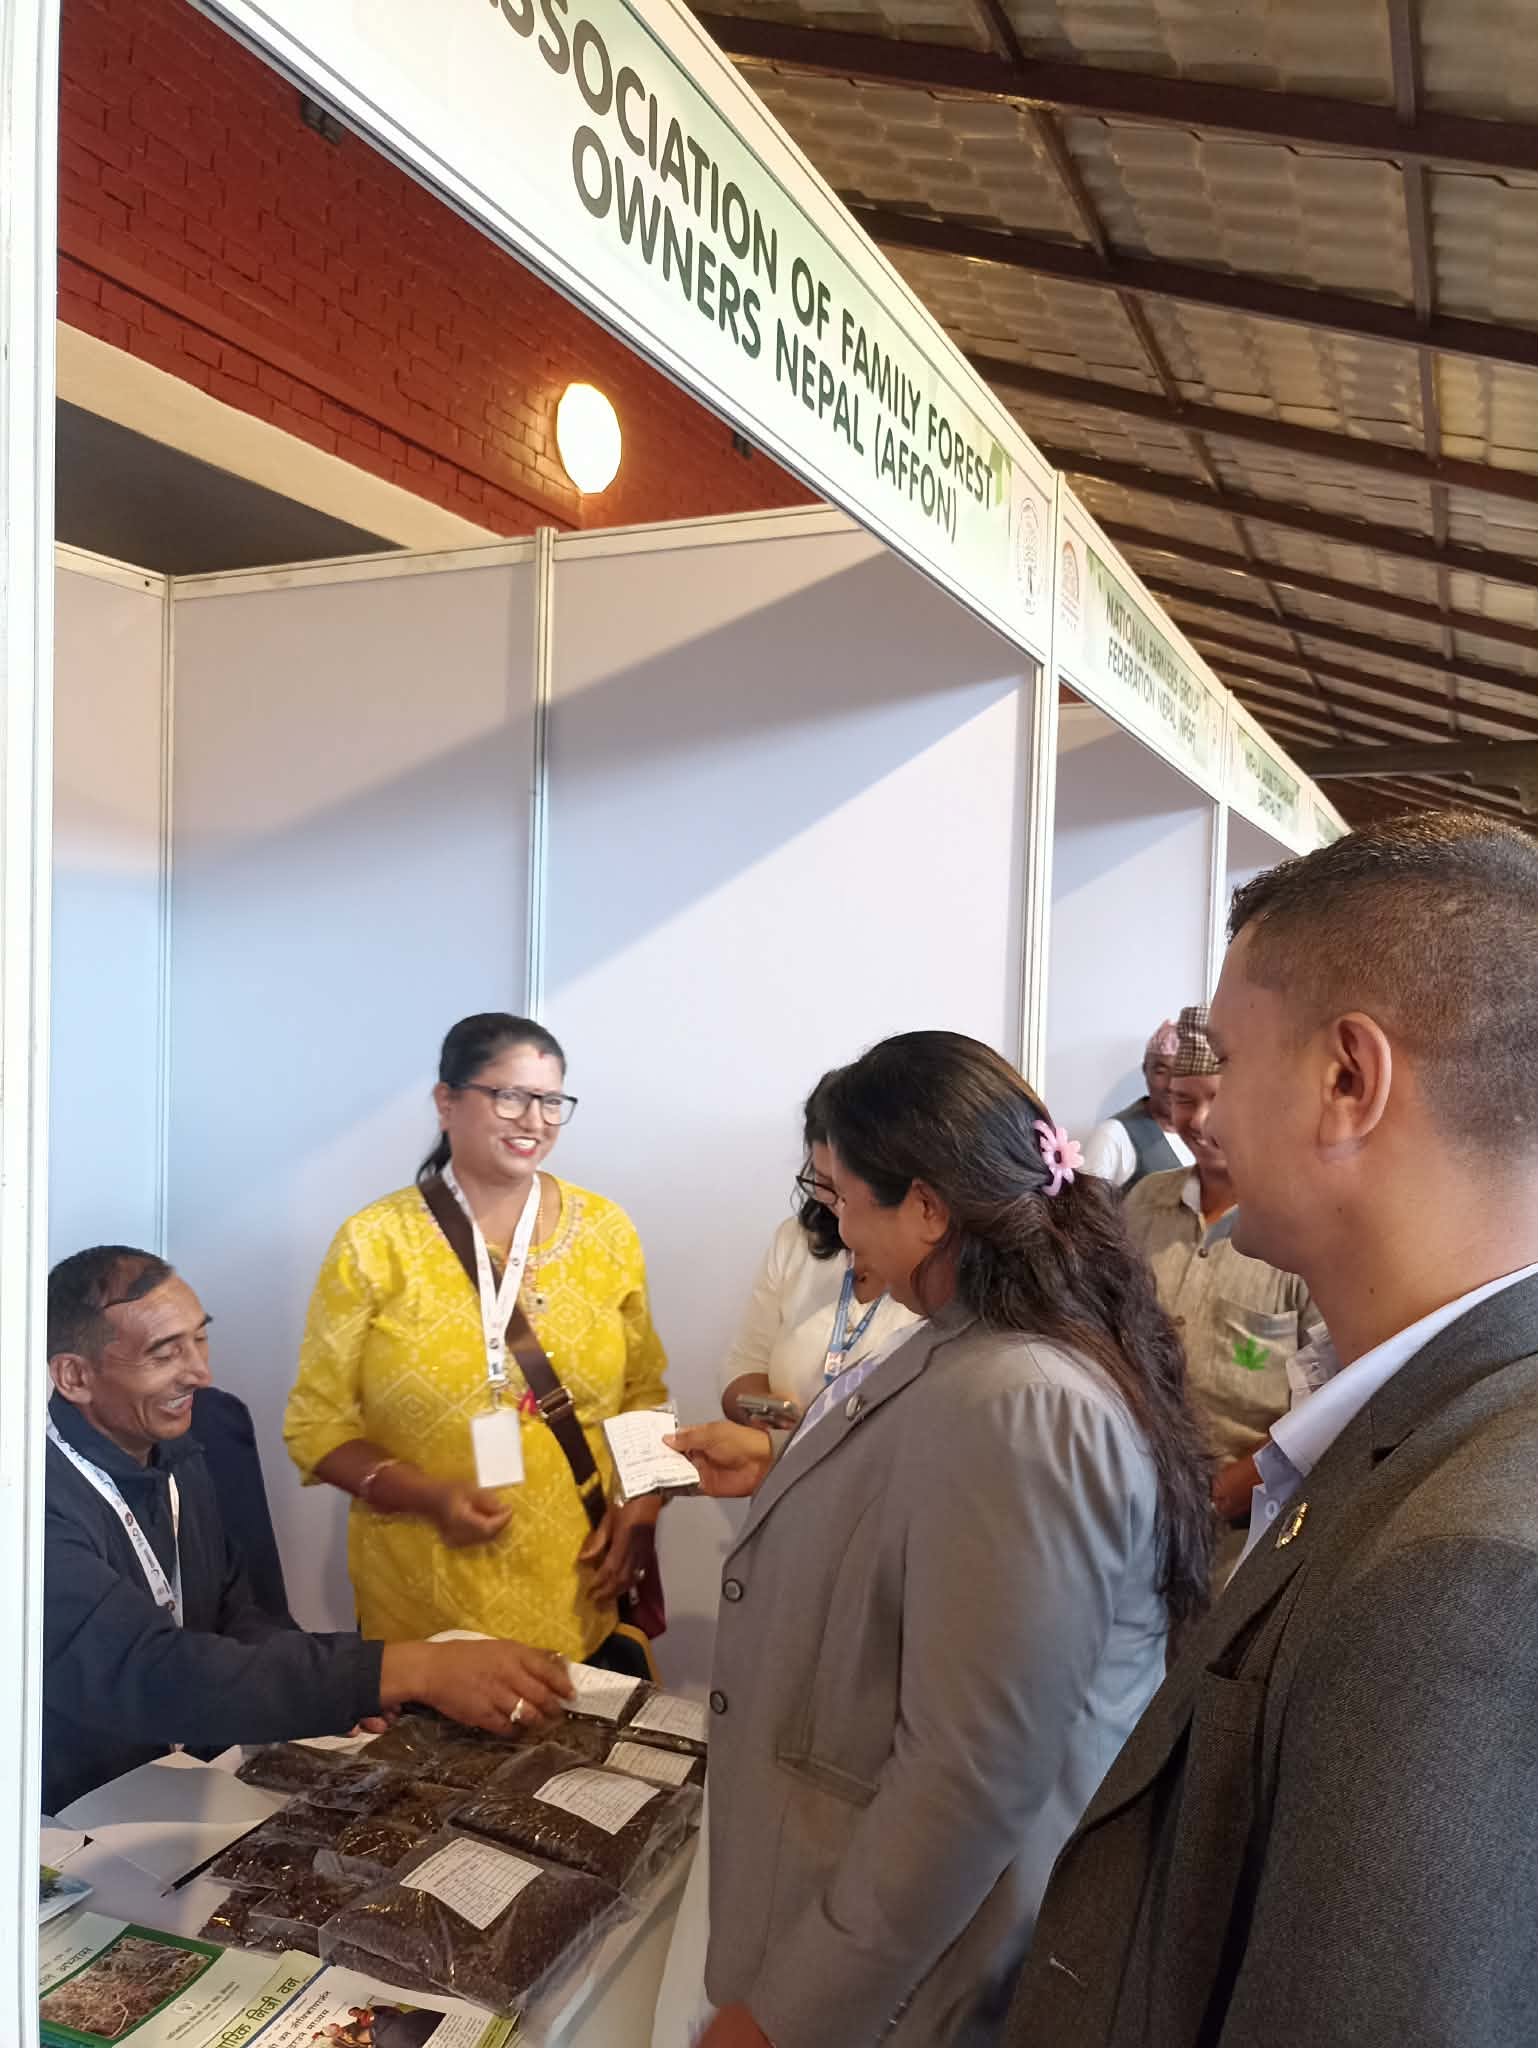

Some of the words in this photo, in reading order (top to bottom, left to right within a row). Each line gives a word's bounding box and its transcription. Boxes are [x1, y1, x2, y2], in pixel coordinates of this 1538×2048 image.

[489, 0, 778, 295] SOCIATION
[791, 257, 832, 340] OF
[842, 308, 922, 427] FAMILY
[928, 403, 994, 511] FOREST
[571, 125, 762, 359] OWNERS
[775, 318, 865, 456] NEPAL
[874, 414, 958, 545] (AFFON)
[1106, 591, 1147, 663] NATIONAL
[1107, 636, 1156, 708] FEDERATION
[246, 1995, 281, 2021] निजी
[276, 1976, 302, 1994] वन
